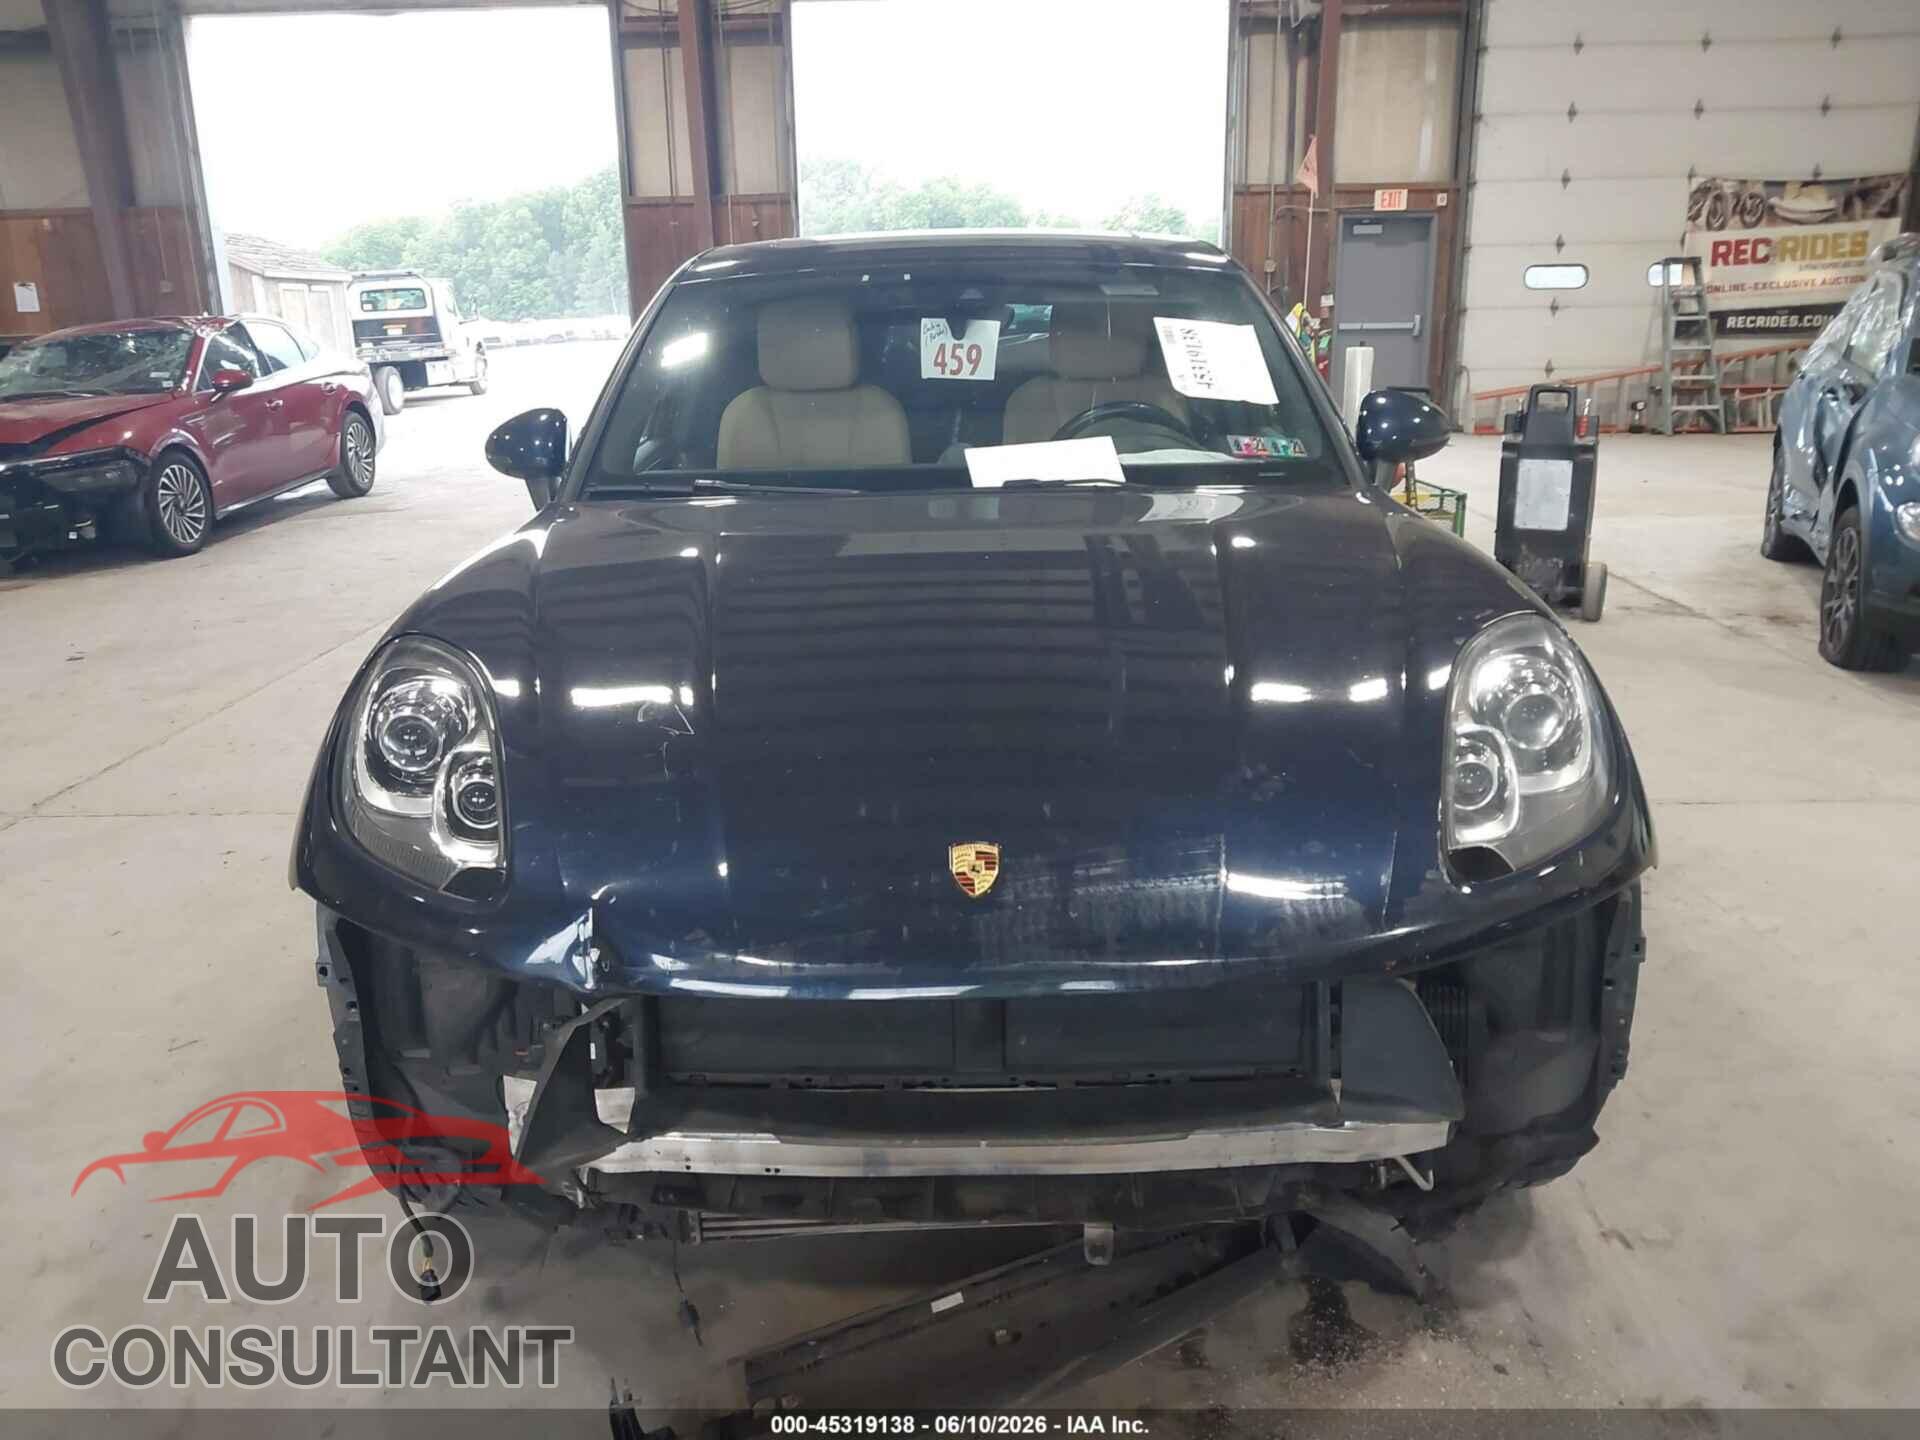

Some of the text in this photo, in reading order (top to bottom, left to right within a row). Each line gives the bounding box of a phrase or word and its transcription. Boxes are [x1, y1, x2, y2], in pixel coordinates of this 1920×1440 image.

[1381, 191, 1402, 209] EXIT
[1710, 230, 1870, 267] REC RIDES
[1706, 279, 1818, 294] ONLINE-EXCLUSIVE
[933, 343, 983, 376] 459
